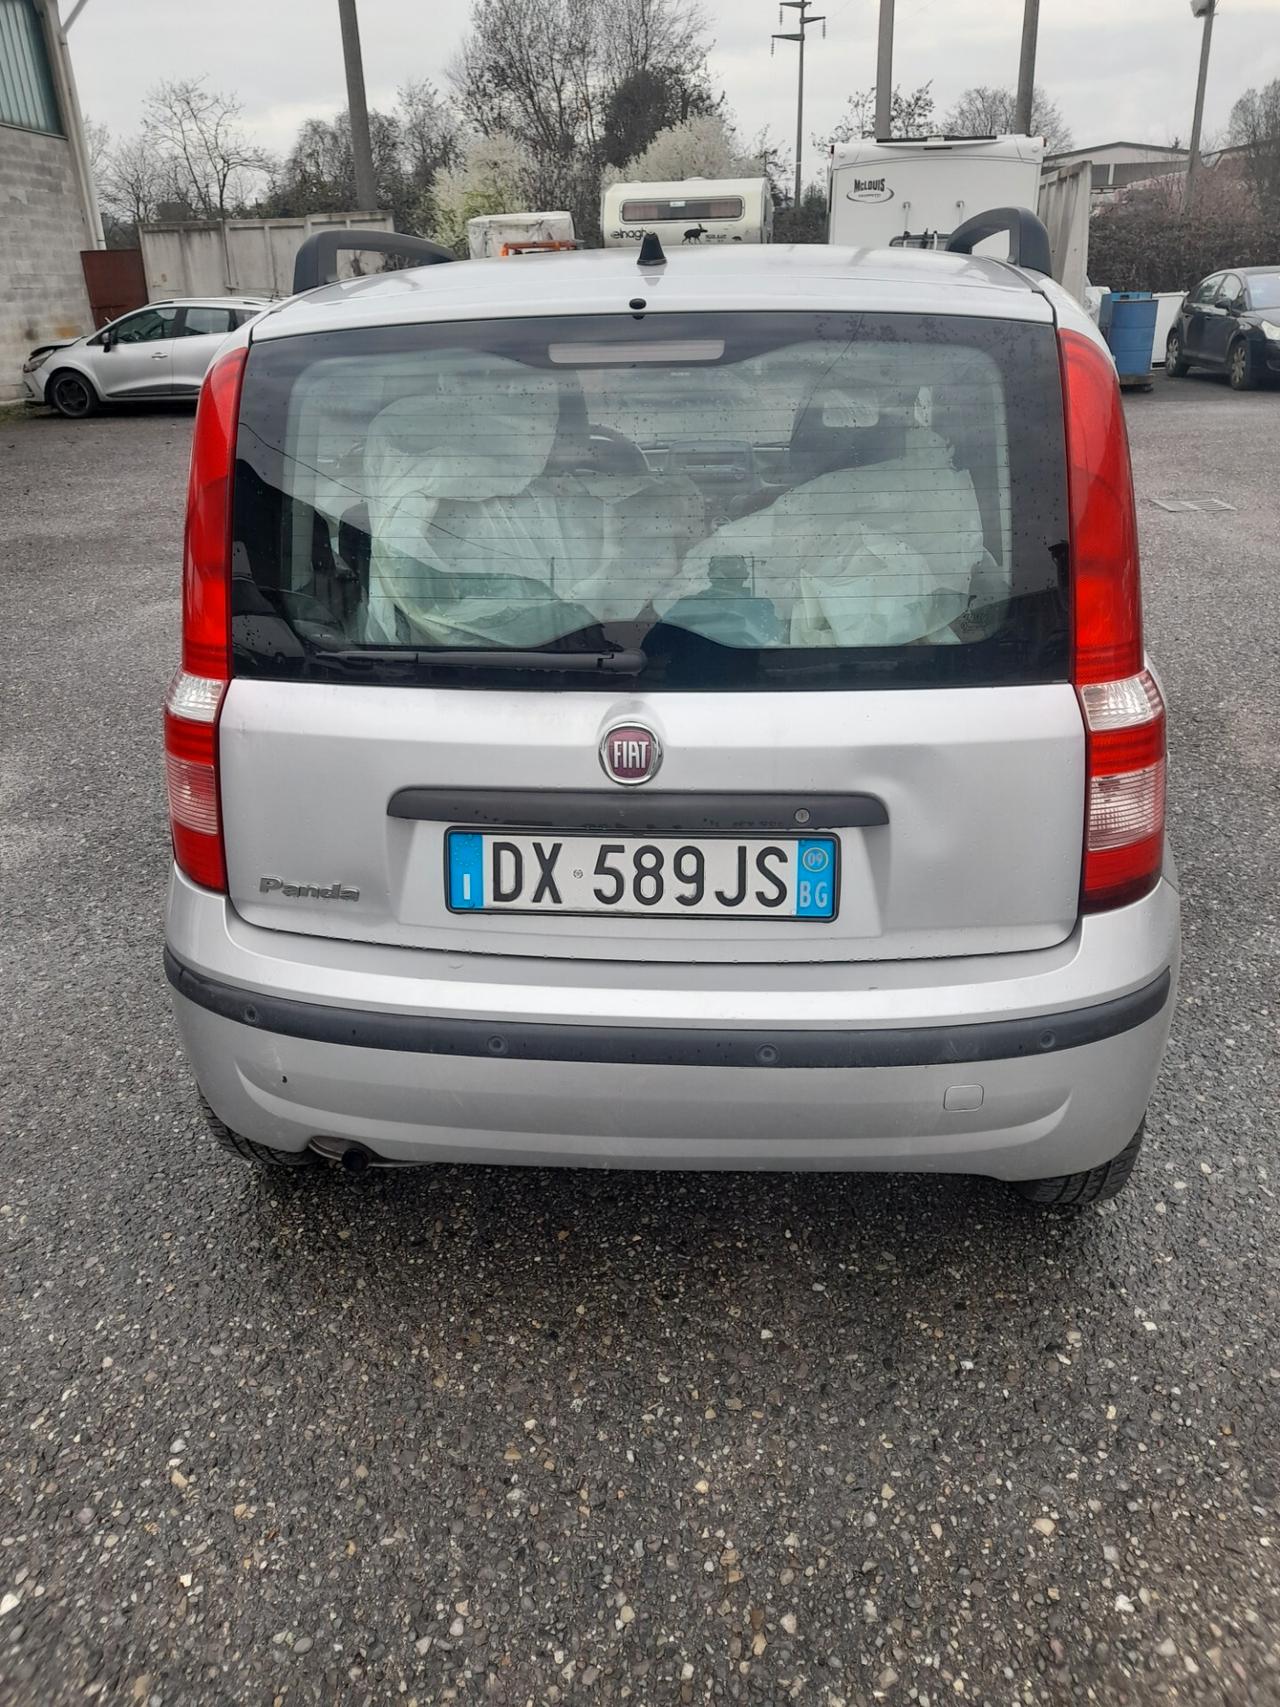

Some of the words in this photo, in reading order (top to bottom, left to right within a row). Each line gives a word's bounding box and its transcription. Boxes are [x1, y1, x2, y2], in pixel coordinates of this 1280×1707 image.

[613, 741, 649, 769] FIAT
[492, 842, 563, 904] DX
[807, 853, 823, 867] 09
[259, 876, 360, 902] Panda
[799, 881, 828, 908] BG
